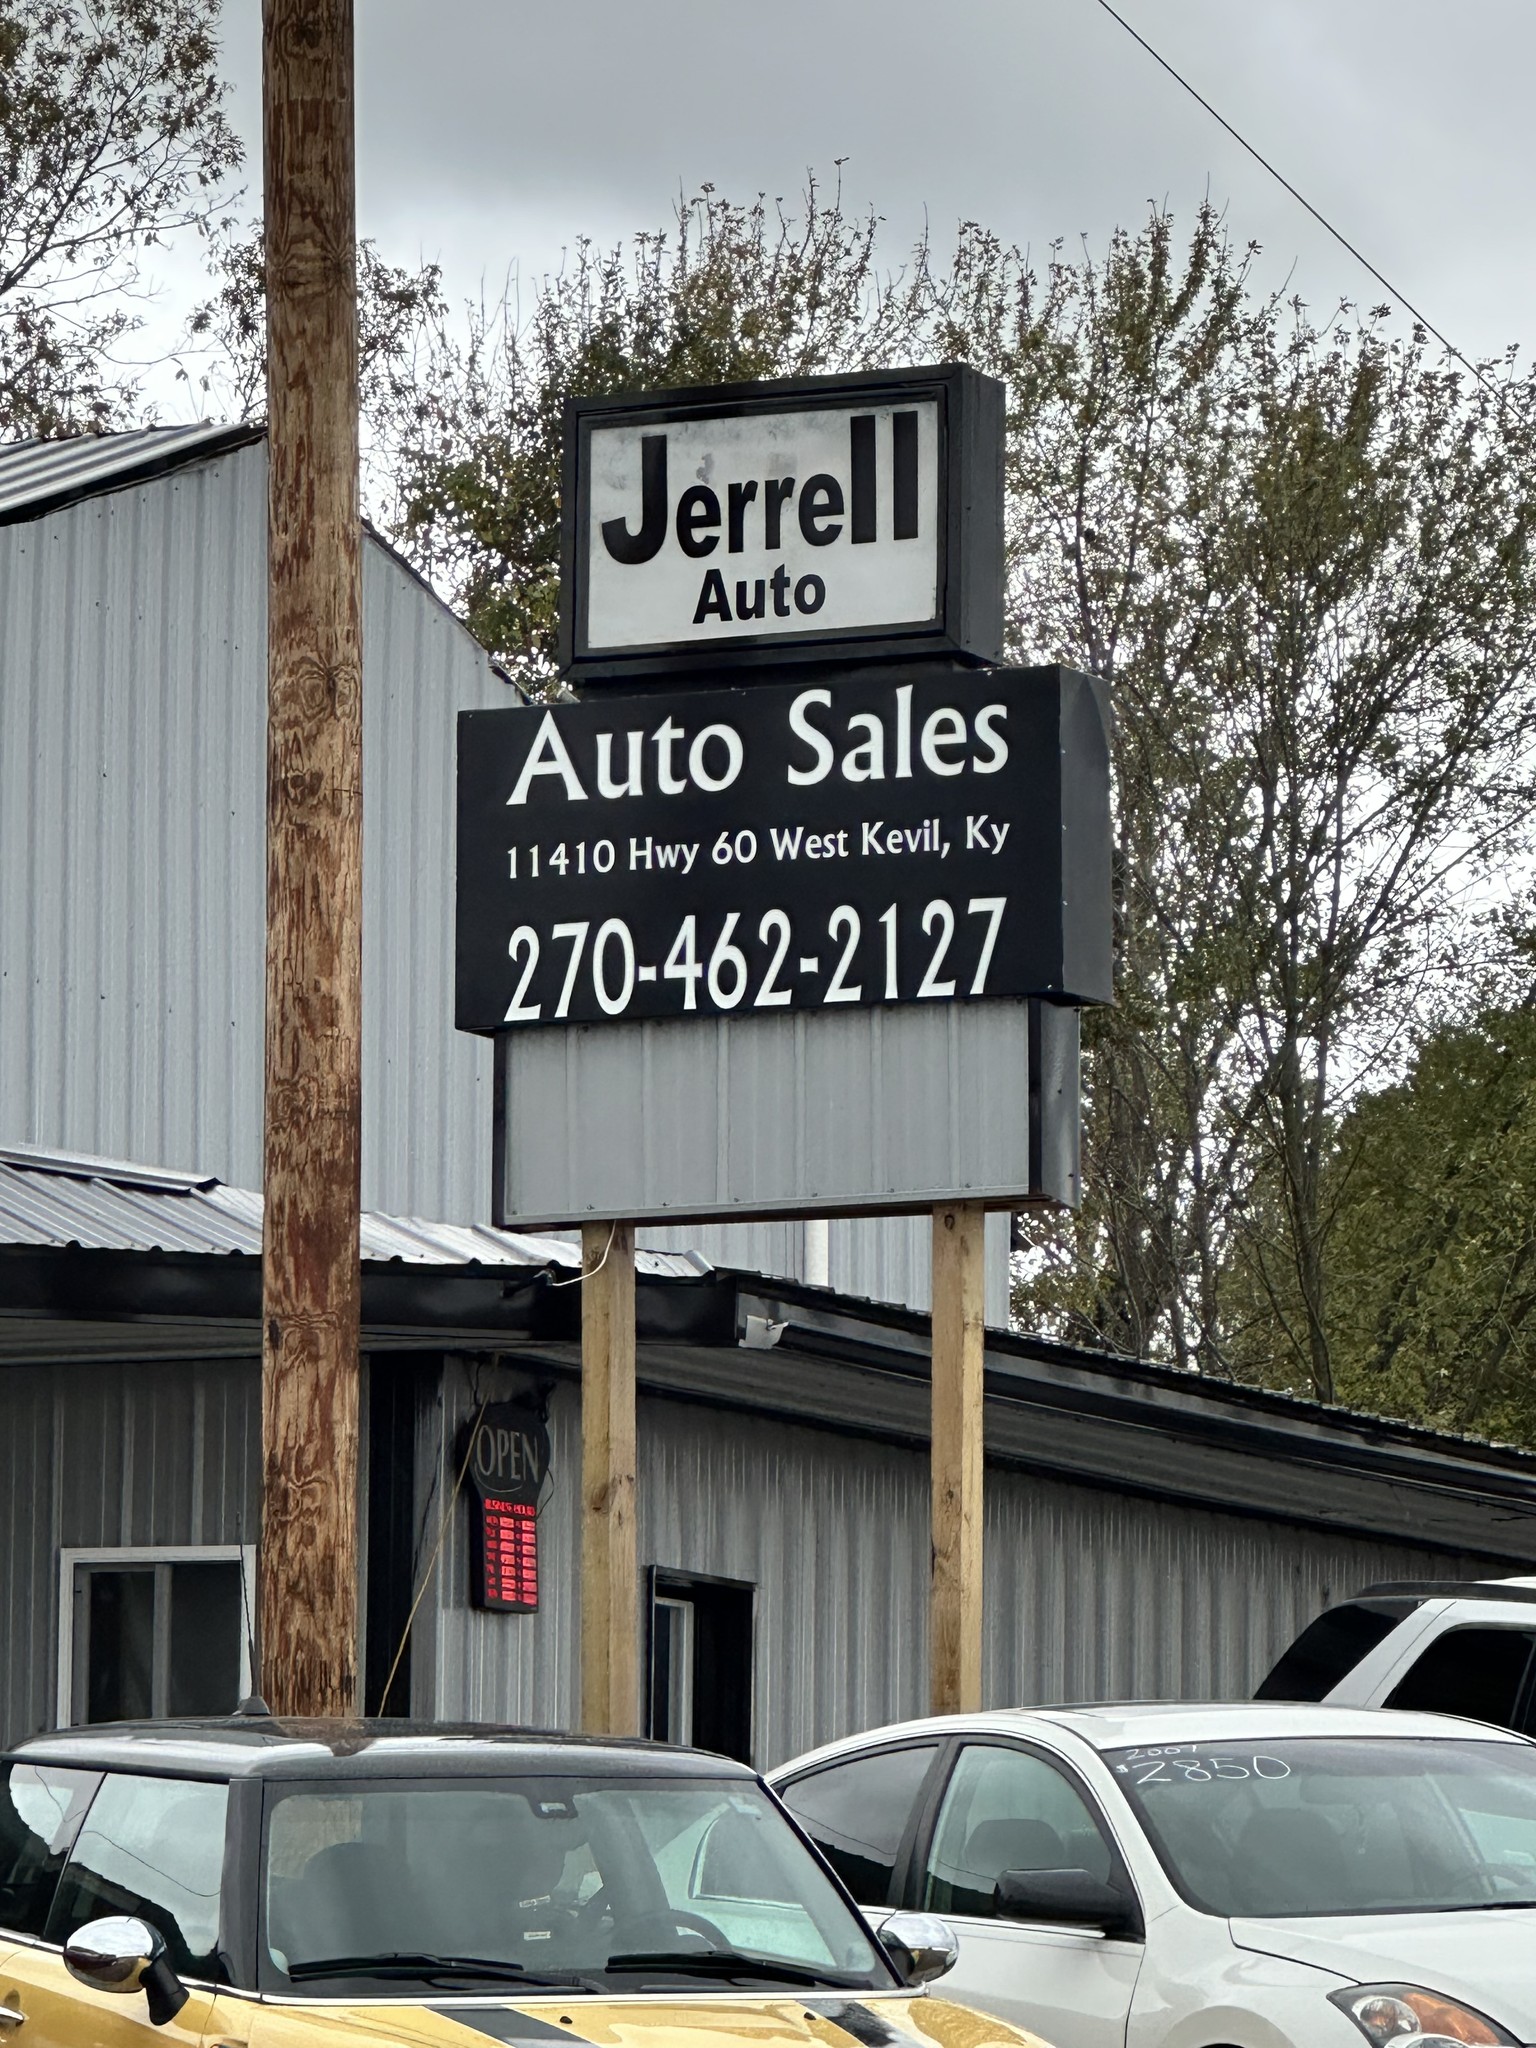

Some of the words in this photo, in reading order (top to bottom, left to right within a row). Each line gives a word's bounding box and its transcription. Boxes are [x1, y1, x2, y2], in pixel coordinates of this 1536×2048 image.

[602, 411, 919, 565] Jerrell
[693, 563, 826, 625] Auto
[506, 710, 744, 806] Auto
[788, 684, 1010, 786] Sales
[507, 839, 616, 879] 11410
[630, 836, 700, 875] Hwy
[711, 829, 757, 865] 60
[770, 826, 849, 861] West
[861, 818, 951, 859] Kevil,
[966, 814, 1011, 855] Ky
[503, 897, 1007, 1022] 270-462-2127
[476, 1424, 539, 1484] OPEN
[1115, 1755, 1291, 1785] $2850
